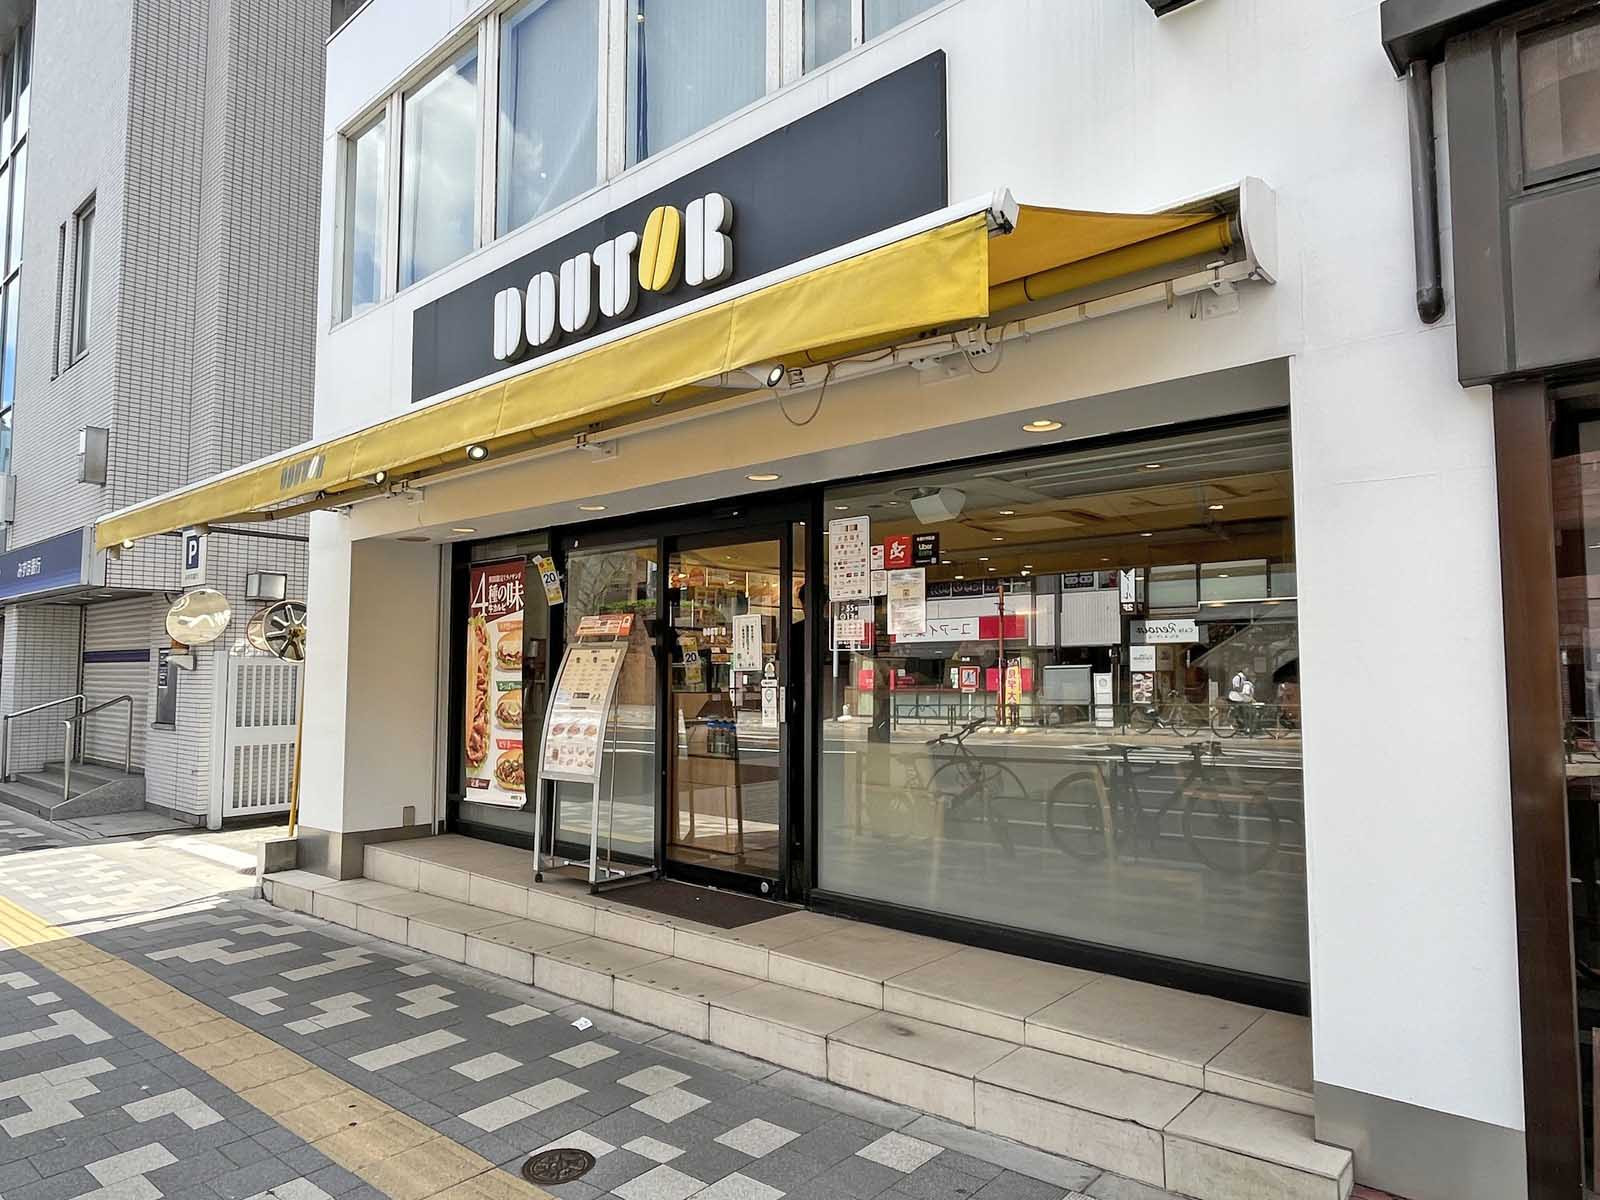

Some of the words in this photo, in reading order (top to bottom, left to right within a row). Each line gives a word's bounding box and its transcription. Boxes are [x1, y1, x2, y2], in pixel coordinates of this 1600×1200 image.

[493, 192, 732, 362] DOUTOR
[188, 540, 198, 565] P
[543, 572, 556, 584] 20
[685, 652, 697, 662] 20
